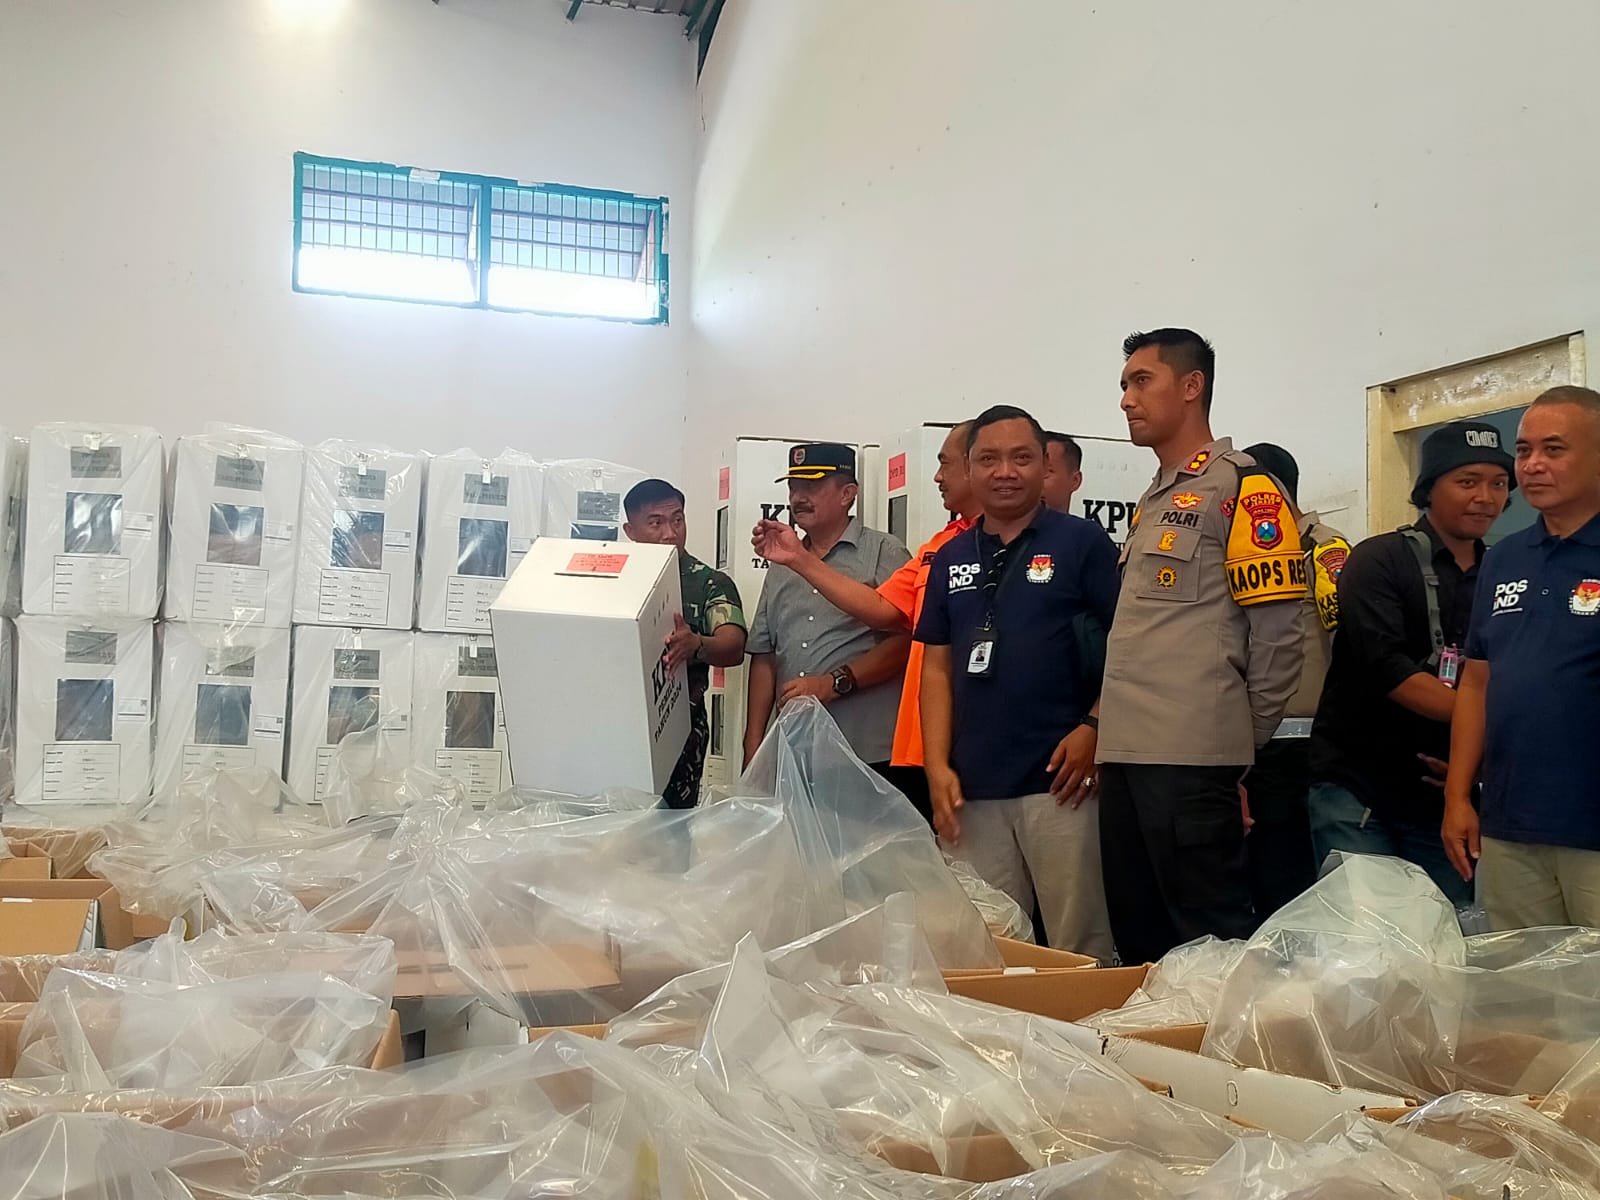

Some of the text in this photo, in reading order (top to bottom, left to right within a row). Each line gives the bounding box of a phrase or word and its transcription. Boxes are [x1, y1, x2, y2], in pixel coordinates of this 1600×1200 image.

[1243, 493, 1282, 508] POLRES
[1160, 511, 1200, 527] POLRI
[949, 563, 981, 577] POS
[1228, 560, 1284, 593] KAOPS
[1495, 579, 1529, 598] POS
